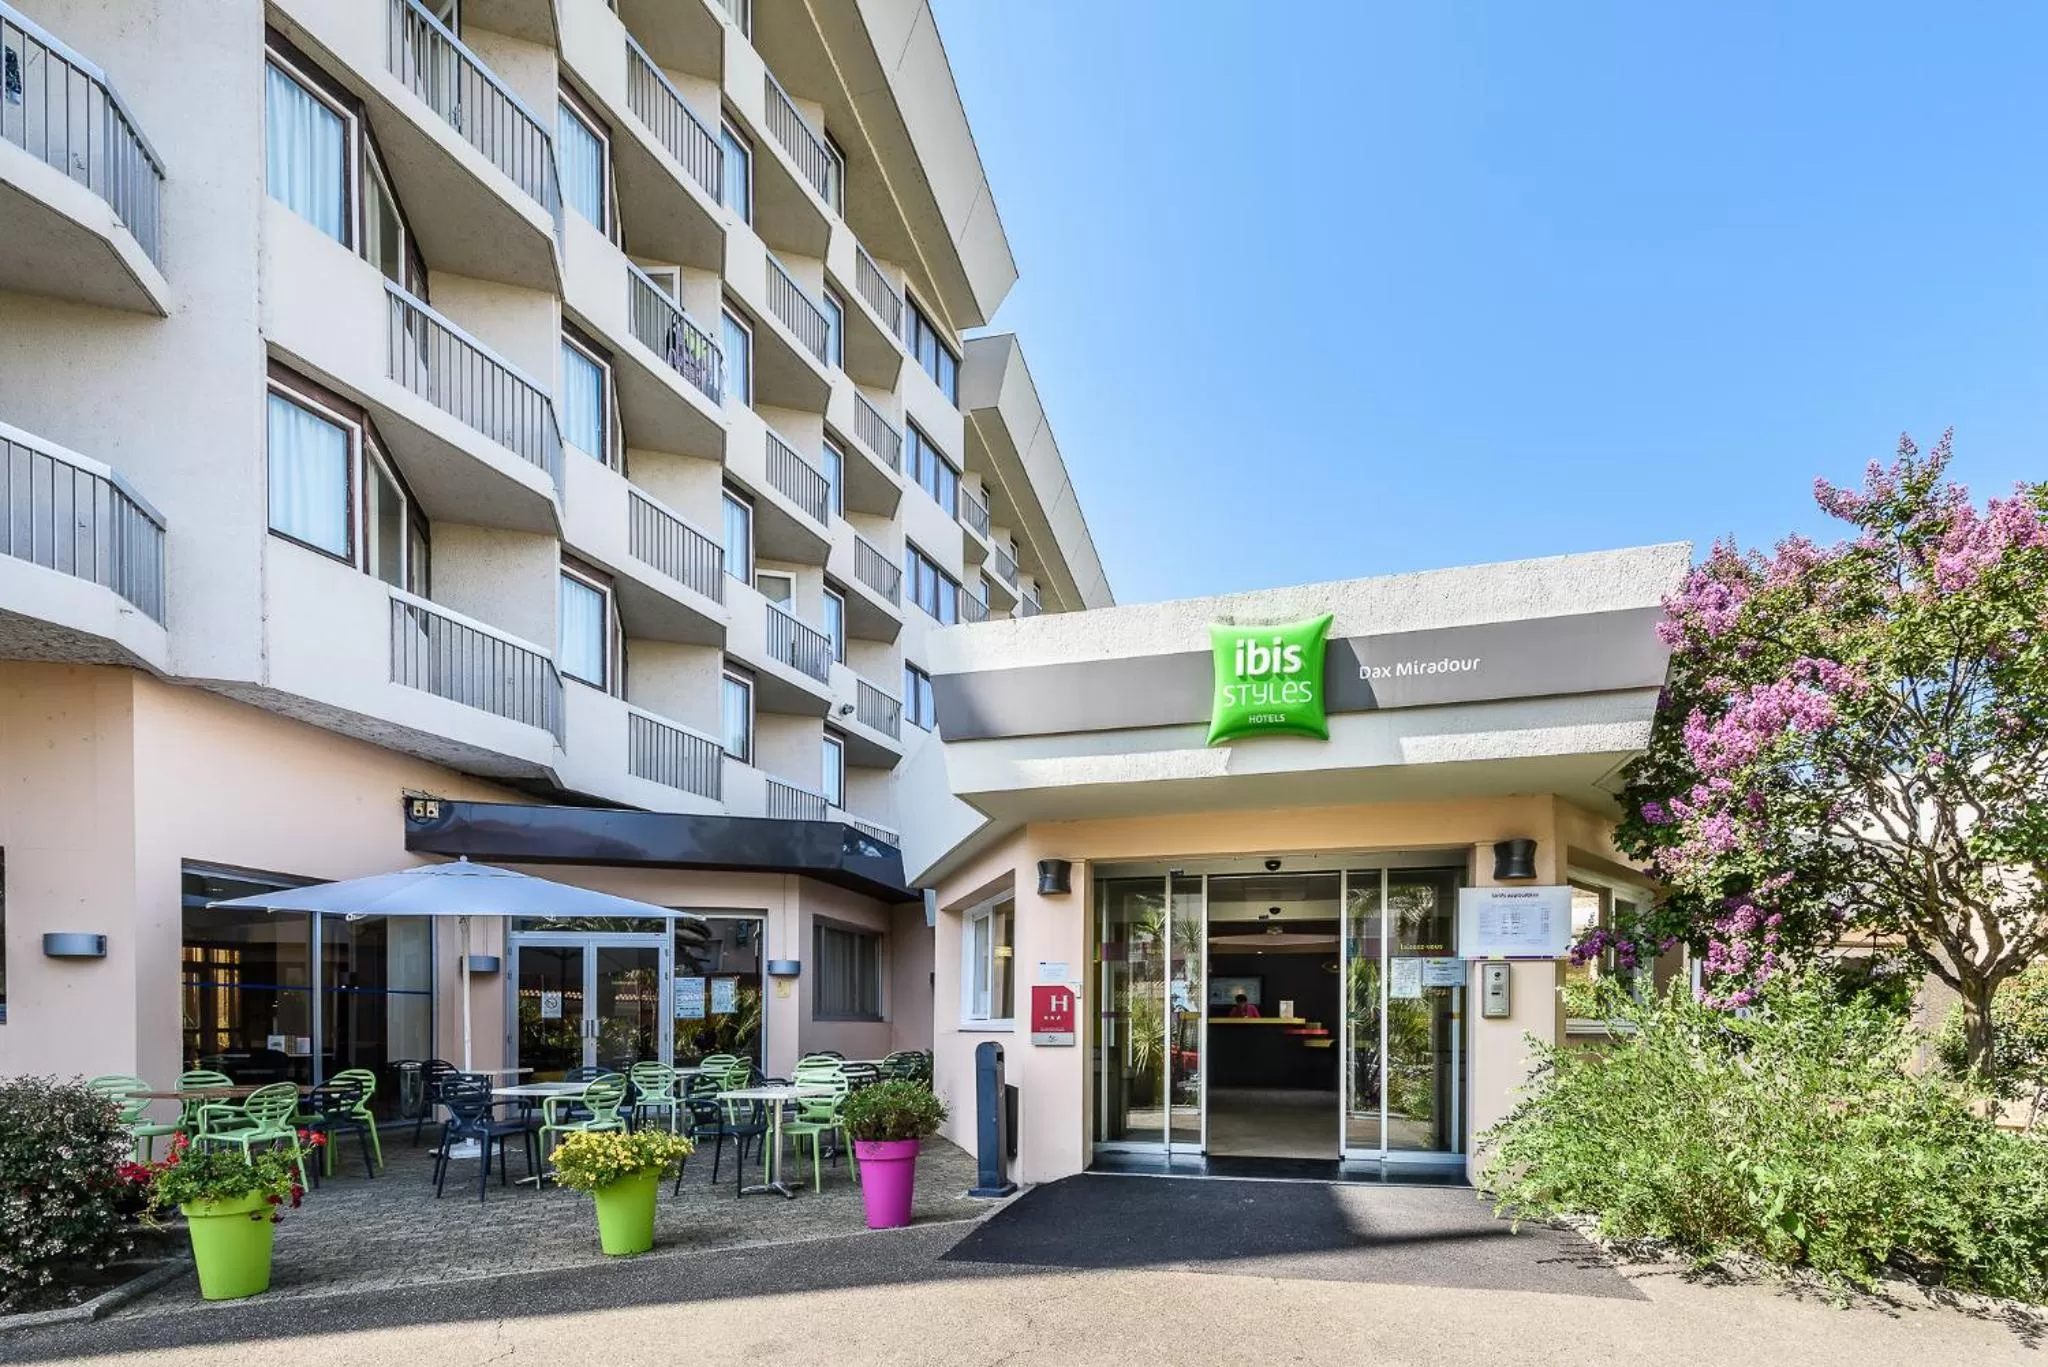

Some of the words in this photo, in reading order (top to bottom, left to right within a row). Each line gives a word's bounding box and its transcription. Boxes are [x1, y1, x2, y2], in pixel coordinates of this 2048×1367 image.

[1235, 637, 1302, 677] ibis
[1360, 665, 1391, 679] Dax
[1396, 658, 1480, 676] Miradour
[1248, 713, 1286, 724] HOTELS
[1050, 994, 1068, 1012] H
